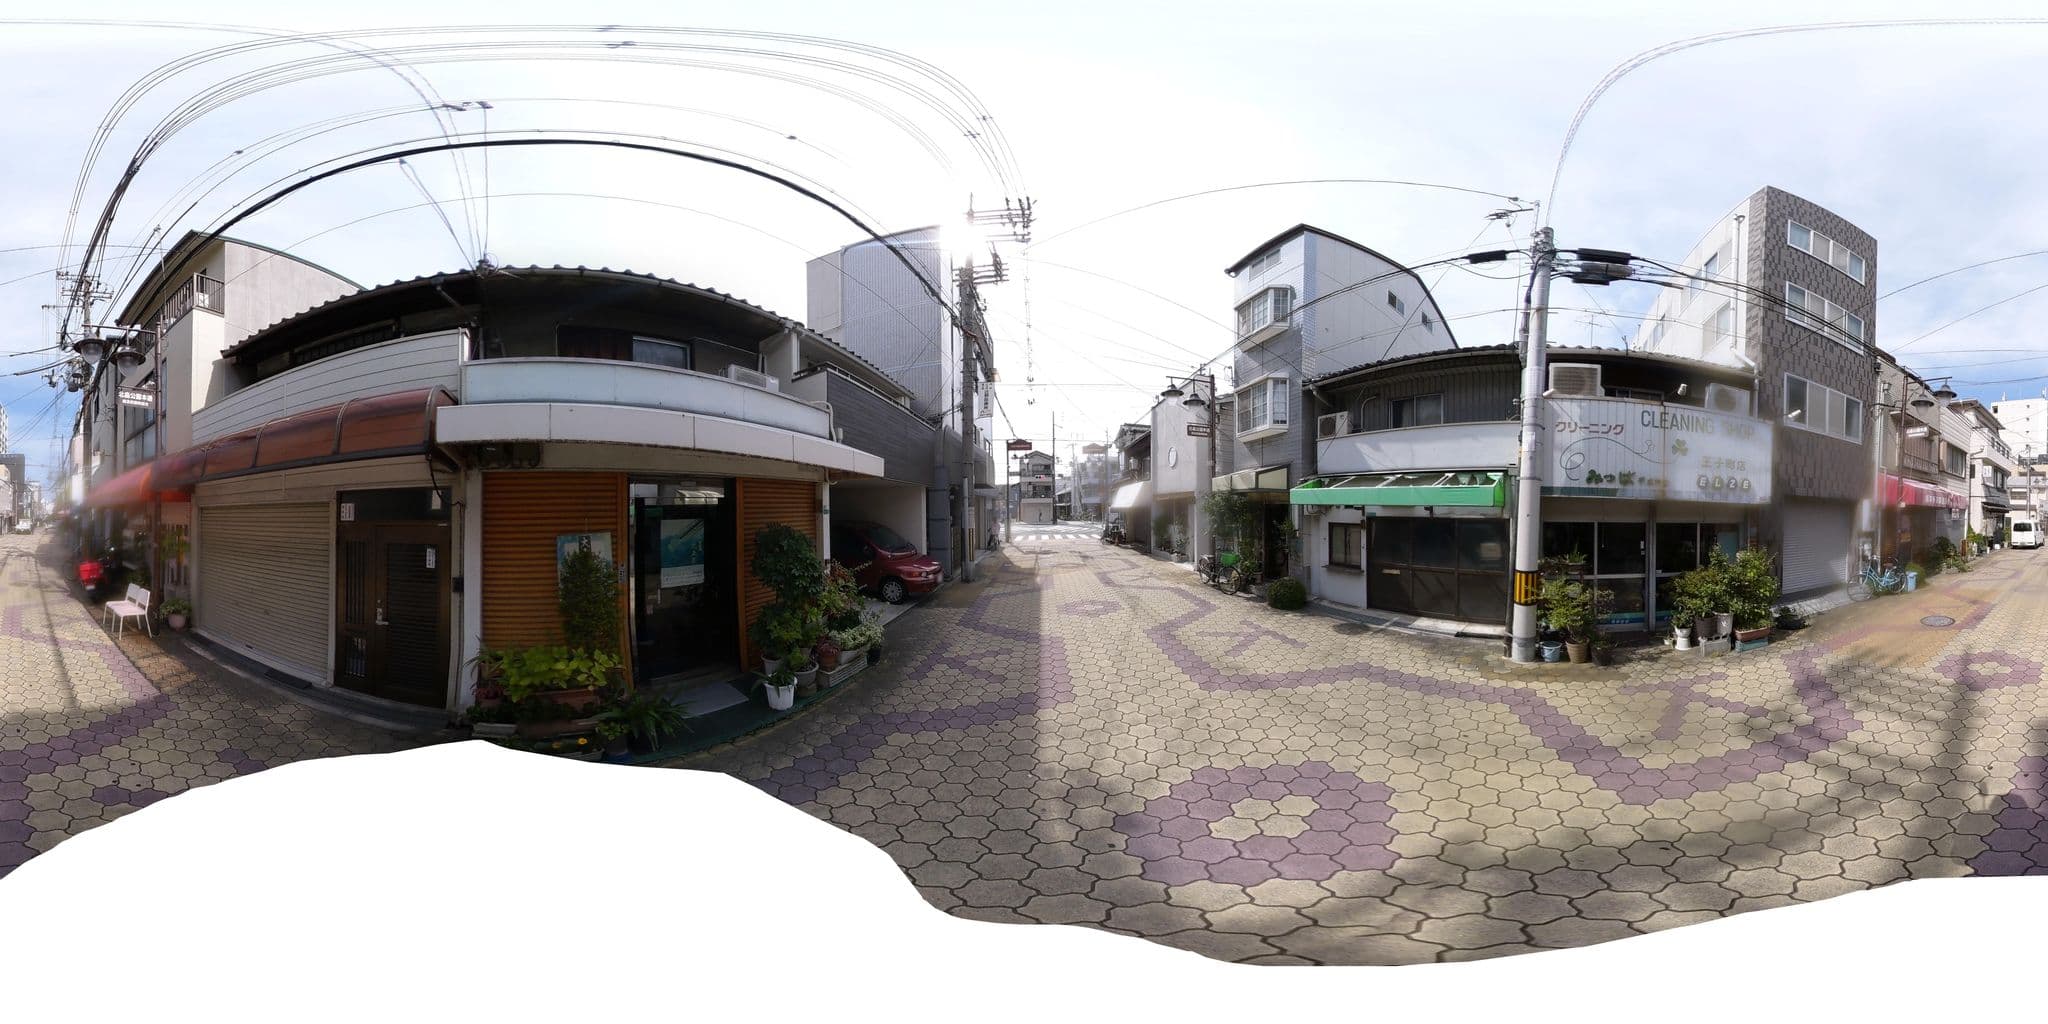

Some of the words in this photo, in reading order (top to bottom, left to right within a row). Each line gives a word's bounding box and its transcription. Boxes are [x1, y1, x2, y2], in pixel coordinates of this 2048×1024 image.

[1555, 421, 1624, 435] クリーニング
[1641, 410, 1714, 434] CLEANING
